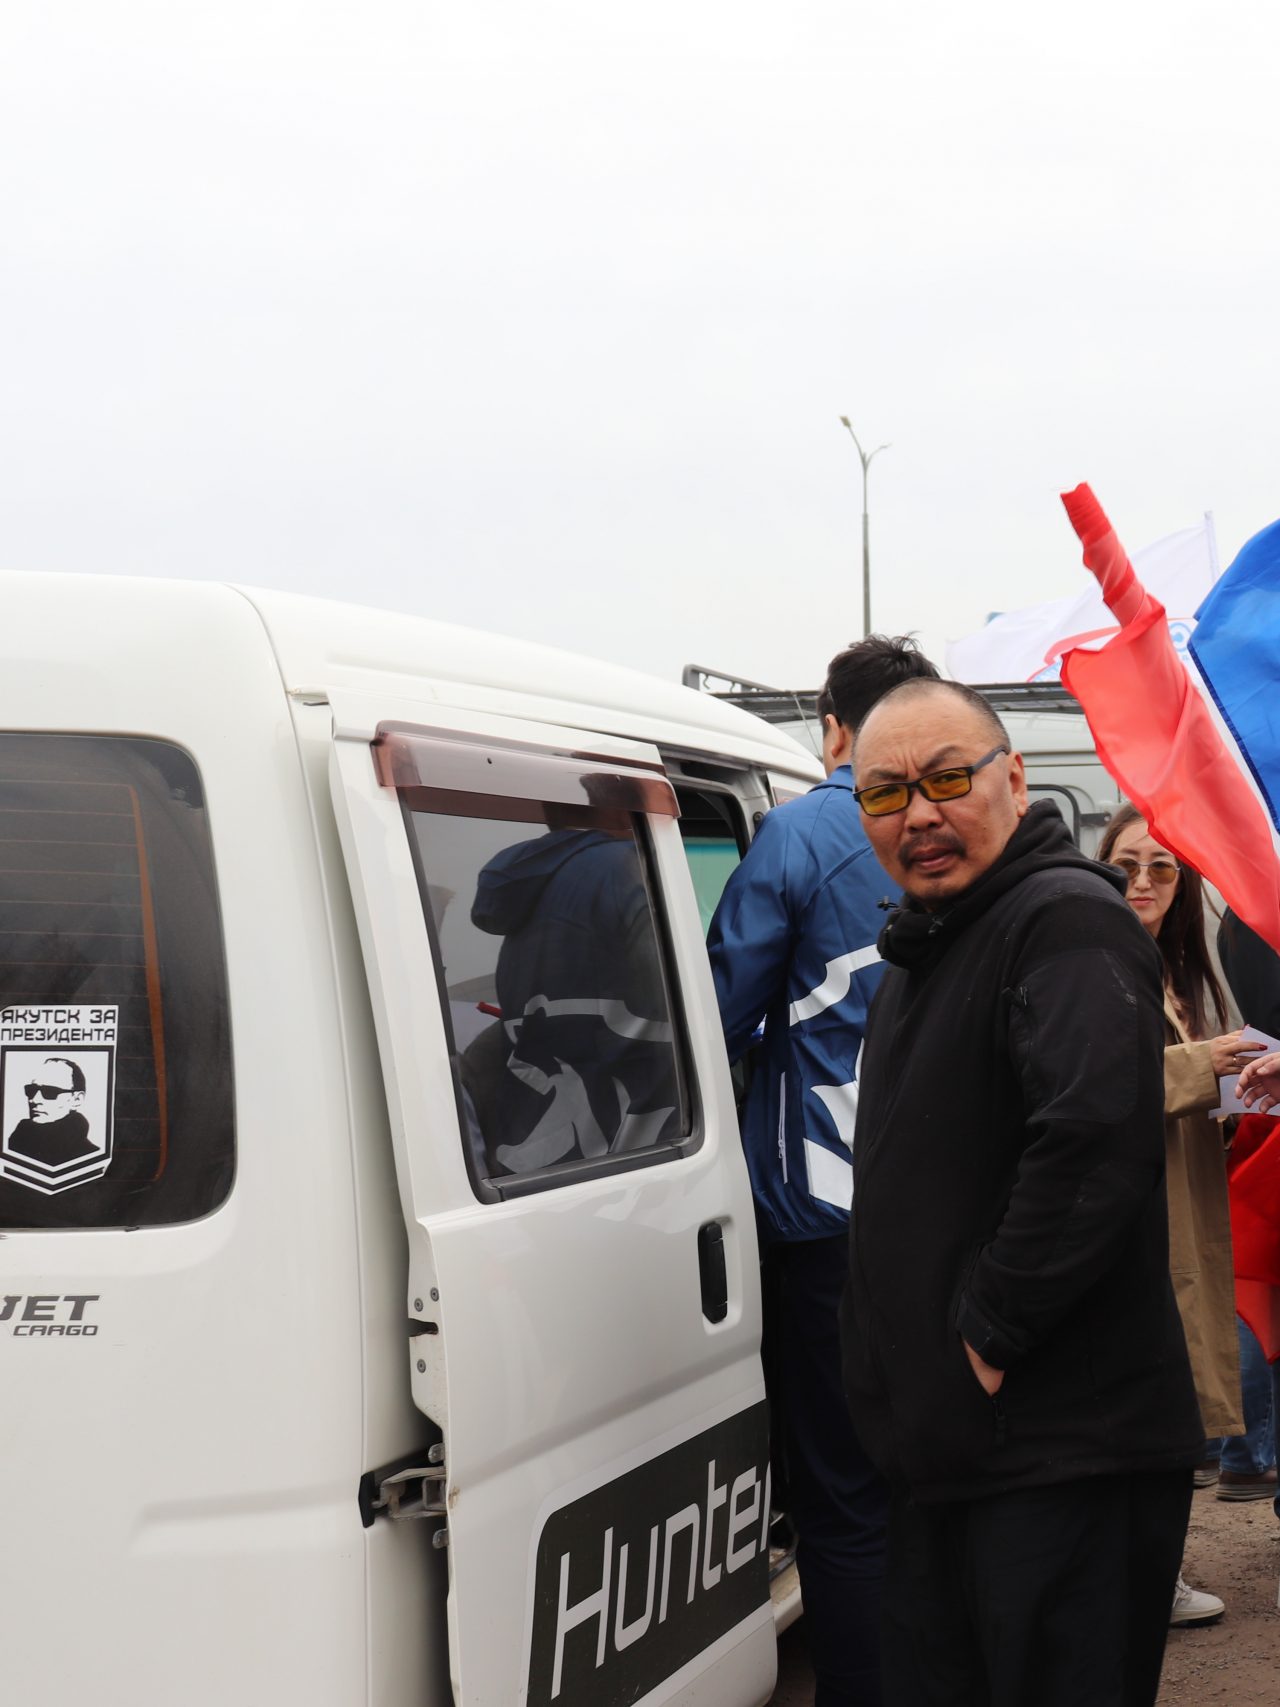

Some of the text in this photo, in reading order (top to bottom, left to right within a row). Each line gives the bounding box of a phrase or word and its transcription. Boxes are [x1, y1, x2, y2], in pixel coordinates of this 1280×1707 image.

[2, 1009, 116, 1023] ЯКУТСК ЗА
[1, 1028, 115, 1043] ПРЕЗИДЕНТА
[13, 1325, 98, 1336] CARGO
